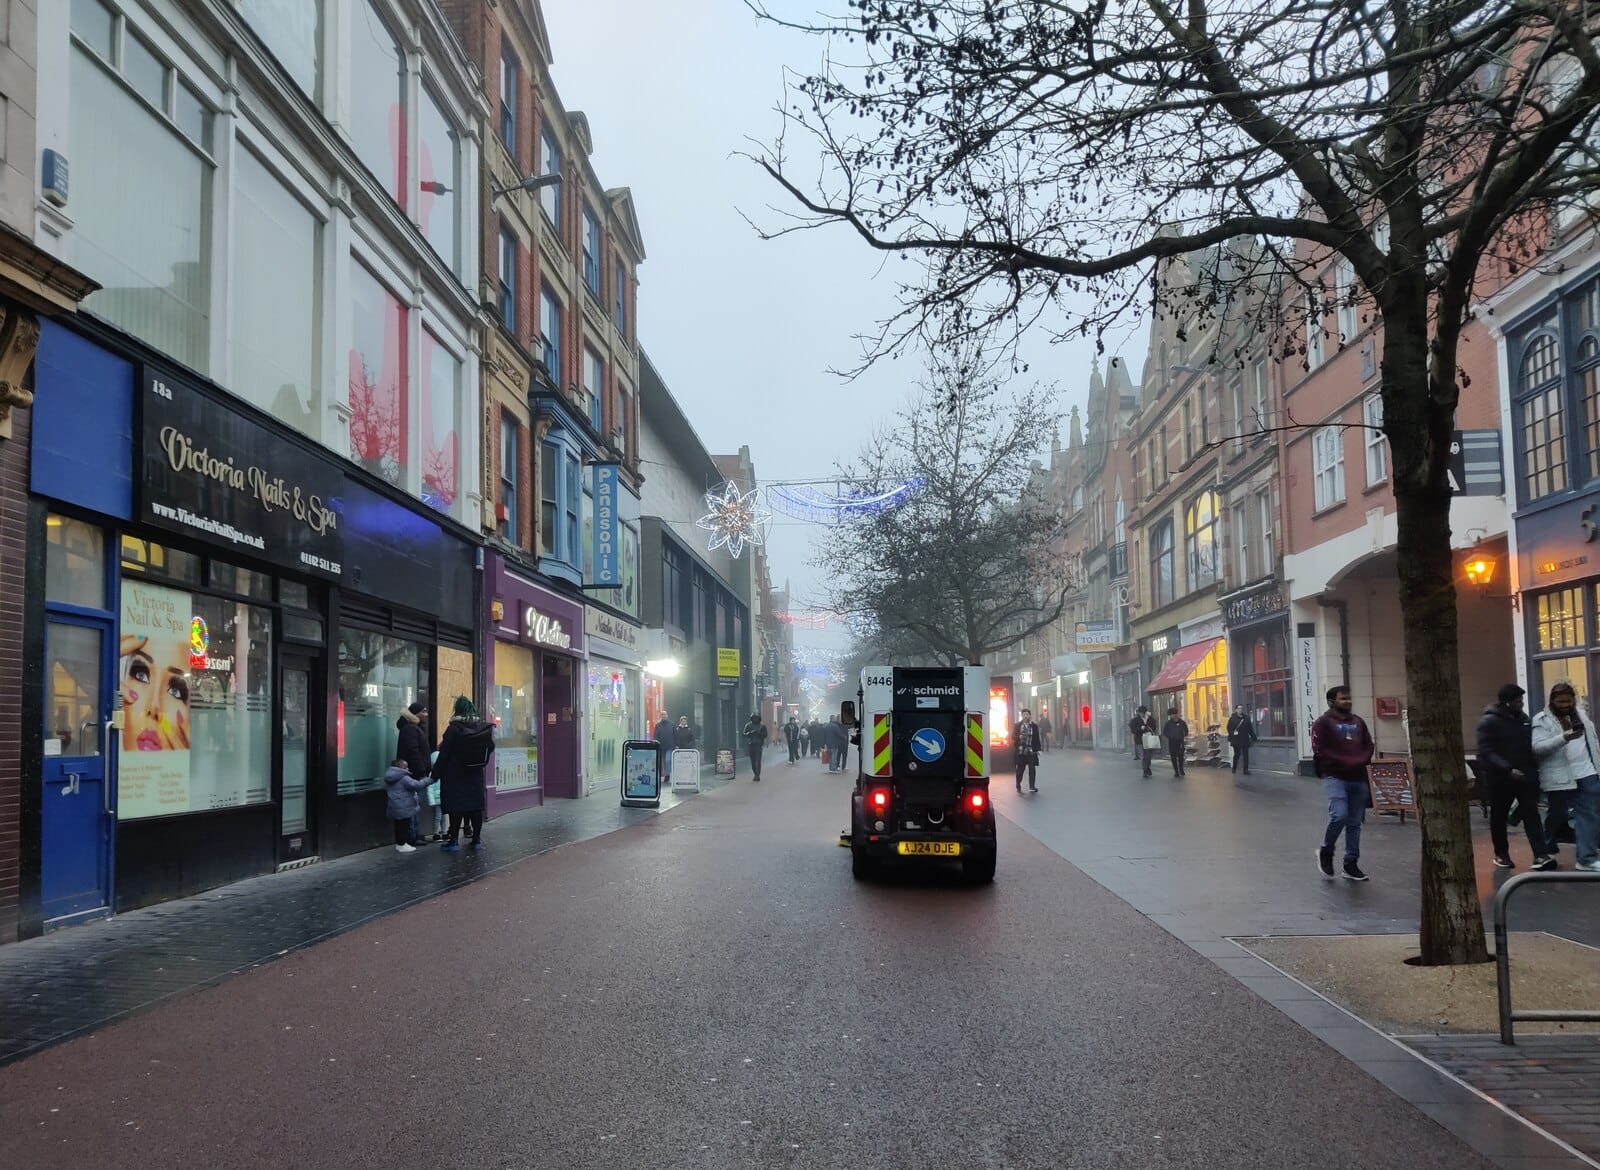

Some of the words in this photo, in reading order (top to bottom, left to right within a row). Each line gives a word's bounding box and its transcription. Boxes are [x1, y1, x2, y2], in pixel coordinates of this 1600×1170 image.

[152, 379, 173, 400] 18a
[159, 426, 245, 491] Victoria
[248, 466, 291, 513] Nails
[293, 486, 307, 522] &
[308, 495, 337, 537] Spa
[151, 502, 266, 550] www.VictoriaNailSpa.co.uk
[598, 467, 612, 581] Panasonic
[133, 588, 175, 614] Victoria
[127, 606, 149, 627] Nail
[151, 610, 162, 629] &
[167, 613, 184, 635] Spa
[1081, 636, 1093, 644] TO
[1095, 635, 1111, 644] LET
[1303, 639, 1313, 697] SERVICE
[866, 676, 893, 687] 8446
[913, 685, 960, 696] schmidt
[903, 842, 931, 854] AJ24
[934, 843, 955, 854] OJE
